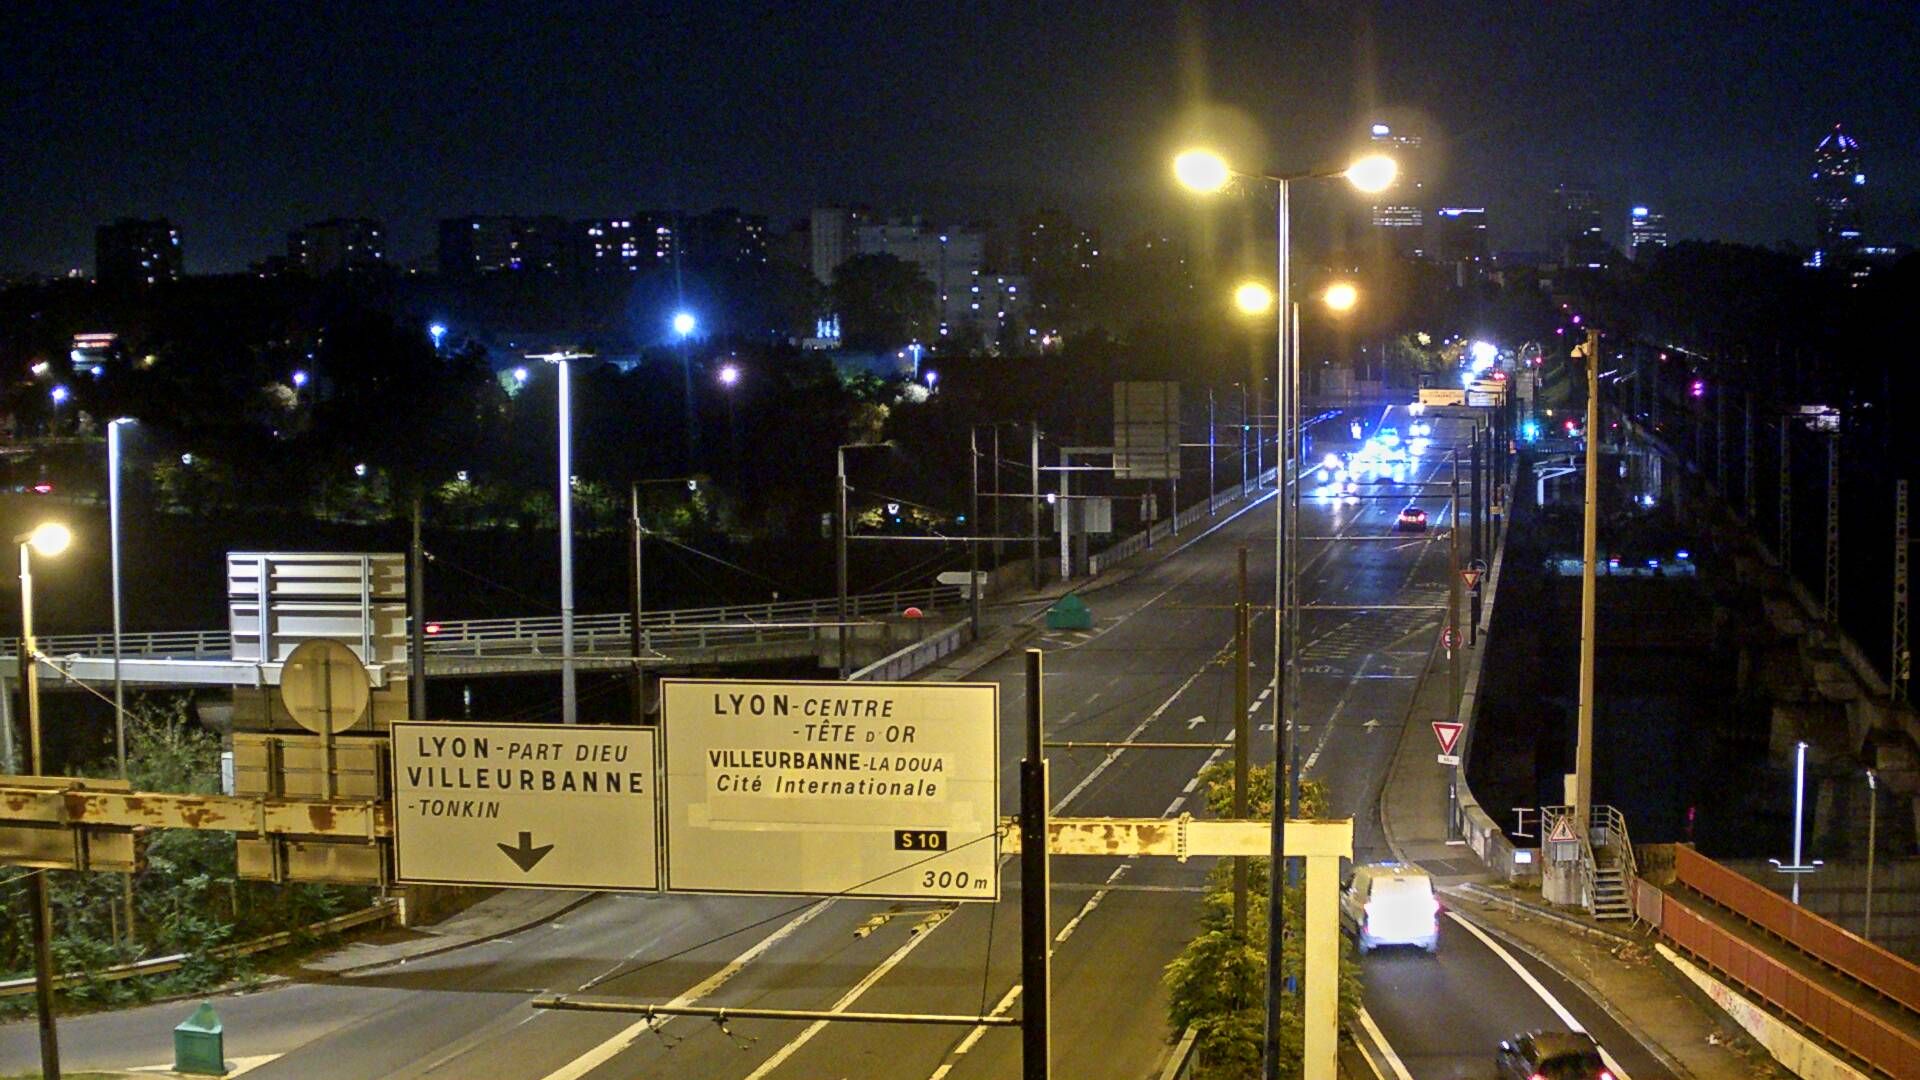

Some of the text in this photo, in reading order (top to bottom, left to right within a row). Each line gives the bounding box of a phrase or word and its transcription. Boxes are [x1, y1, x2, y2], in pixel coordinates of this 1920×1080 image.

[575, 744, 629, 763] DIEU
[894, 757, 943, 773] DOUA
[407, 766, 644, 794] VILLEURBANNE
[716, 773, 937, 797] Cité Internationale
[922, 870, 969, 889] 300
